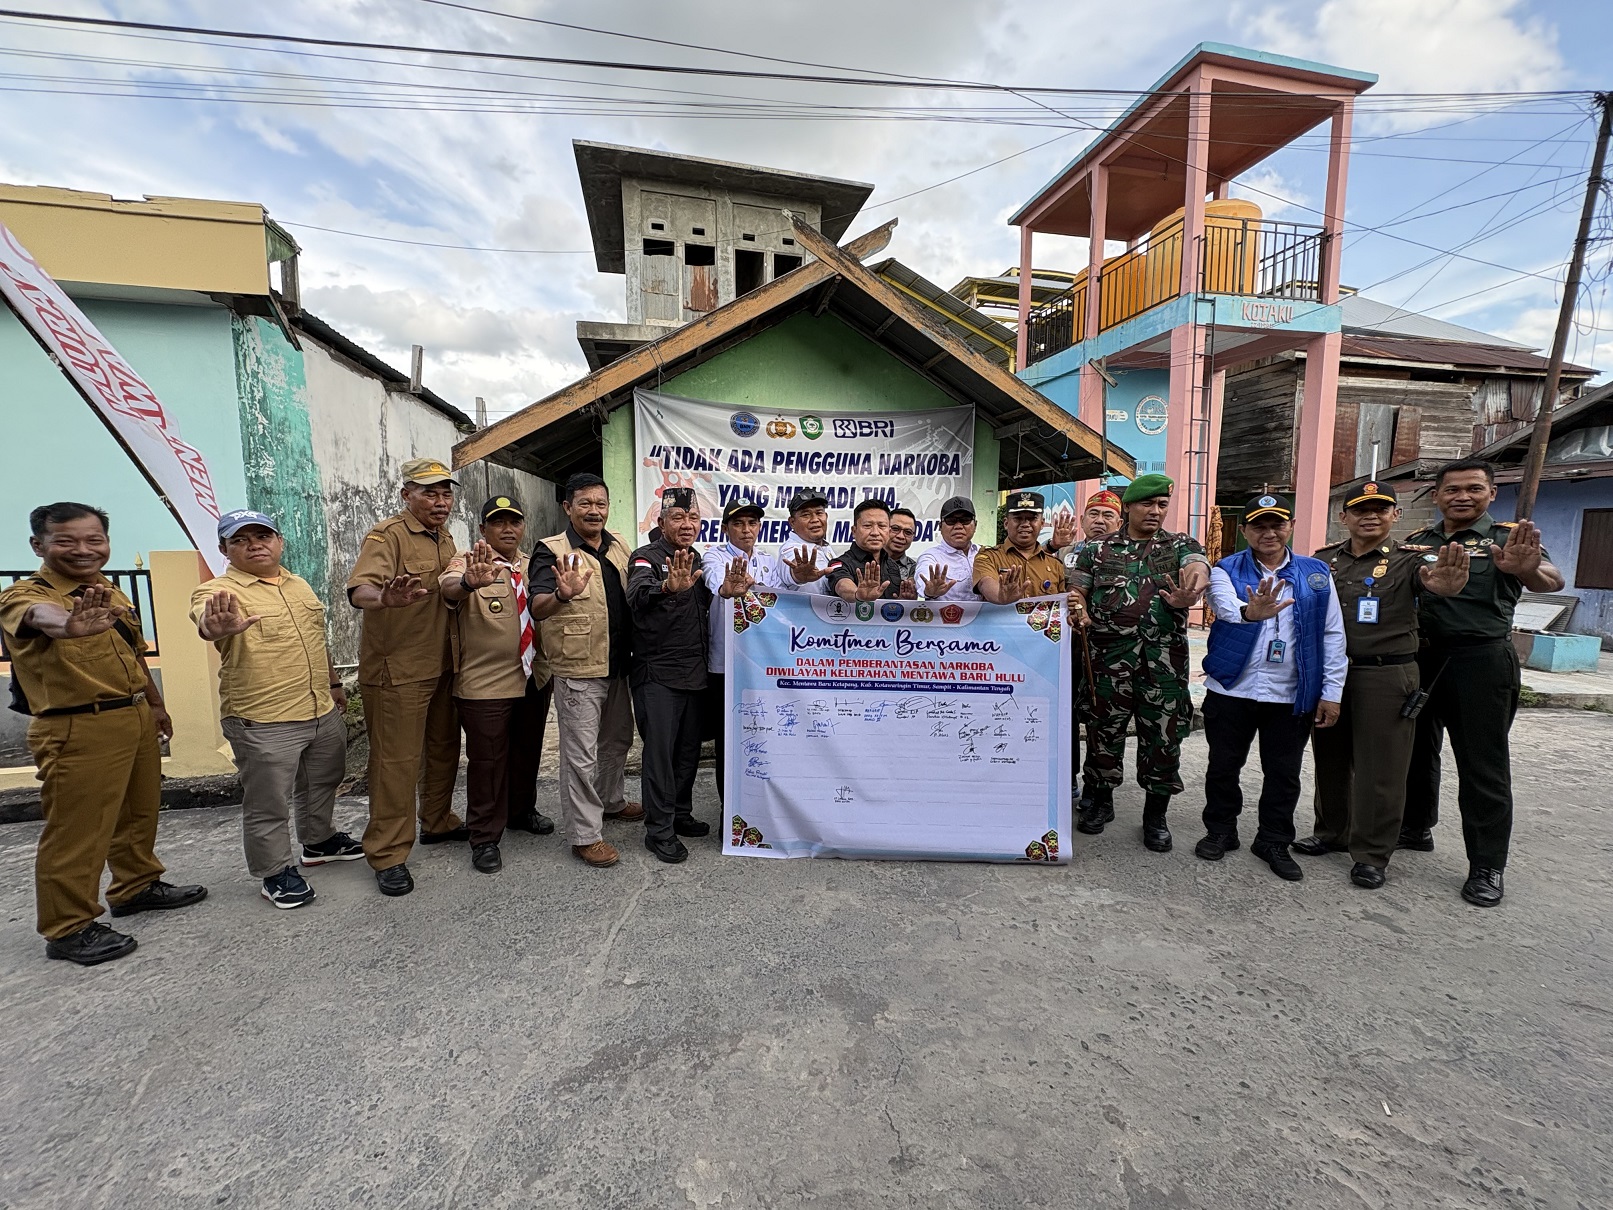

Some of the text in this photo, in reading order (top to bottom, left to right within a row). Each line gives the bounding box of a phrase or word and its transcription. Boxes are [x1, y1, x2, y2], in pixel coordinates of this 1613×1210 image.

[858, 419, 895, 439] BRI
[726, 449, 766, 474] ADA
[771, 450, 873, 476] PENGGUNA
[878, 452, 961, 476] NARKOBA
[718, 484, 770, 509] YANG
[790, 626, 1001, 656] Komitmen Bersama
[765, 667, 1026, 683] DIWILAYAH KELURAHAN MENTAWA BARU HULU
[796, 657, 995, 671] DALAM PEMBERANTASAN NARKOBA
